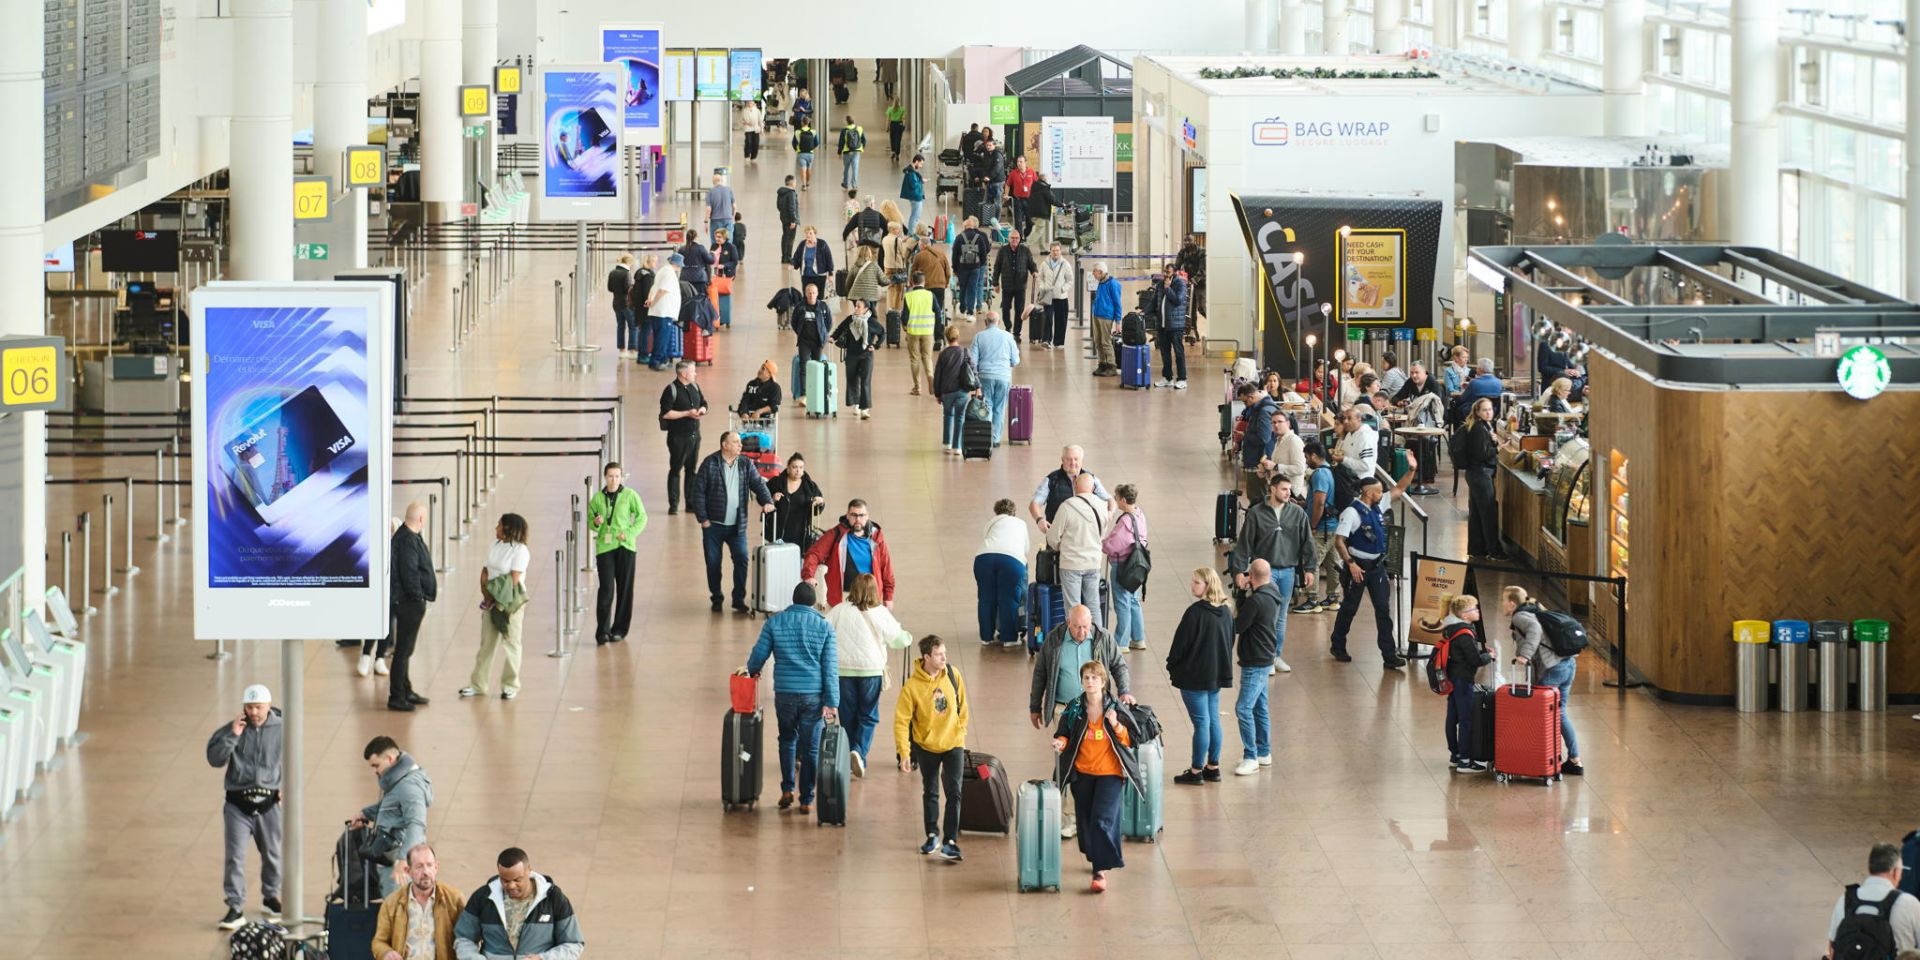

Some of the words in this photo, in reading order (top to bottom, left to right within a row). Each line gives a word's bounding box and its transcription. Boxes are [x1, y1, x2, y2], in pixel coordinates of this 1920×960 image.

[503, 77, 516, 88] 10
[467, 97, 484, 110] 09
[1295, 122, 1332, 137] BAG
[1338, 122, 1390, 137] WRAP
[1295, 138, 1335, 147] SECURE
[1339, 138, 1390, 147] LUGGAGE
[355, 162, 377, 179] 08
[298, 195, 323, 213] 07
[1257, 220, 1323, 333] CASH
[253, 320, 276, 329] VISA
[1821, 337, 1833, 353] H
[11, 367, 49, 396] 06
[231, 428, 268, 456] Revolut
[327, 435, 353, 454] VISA
